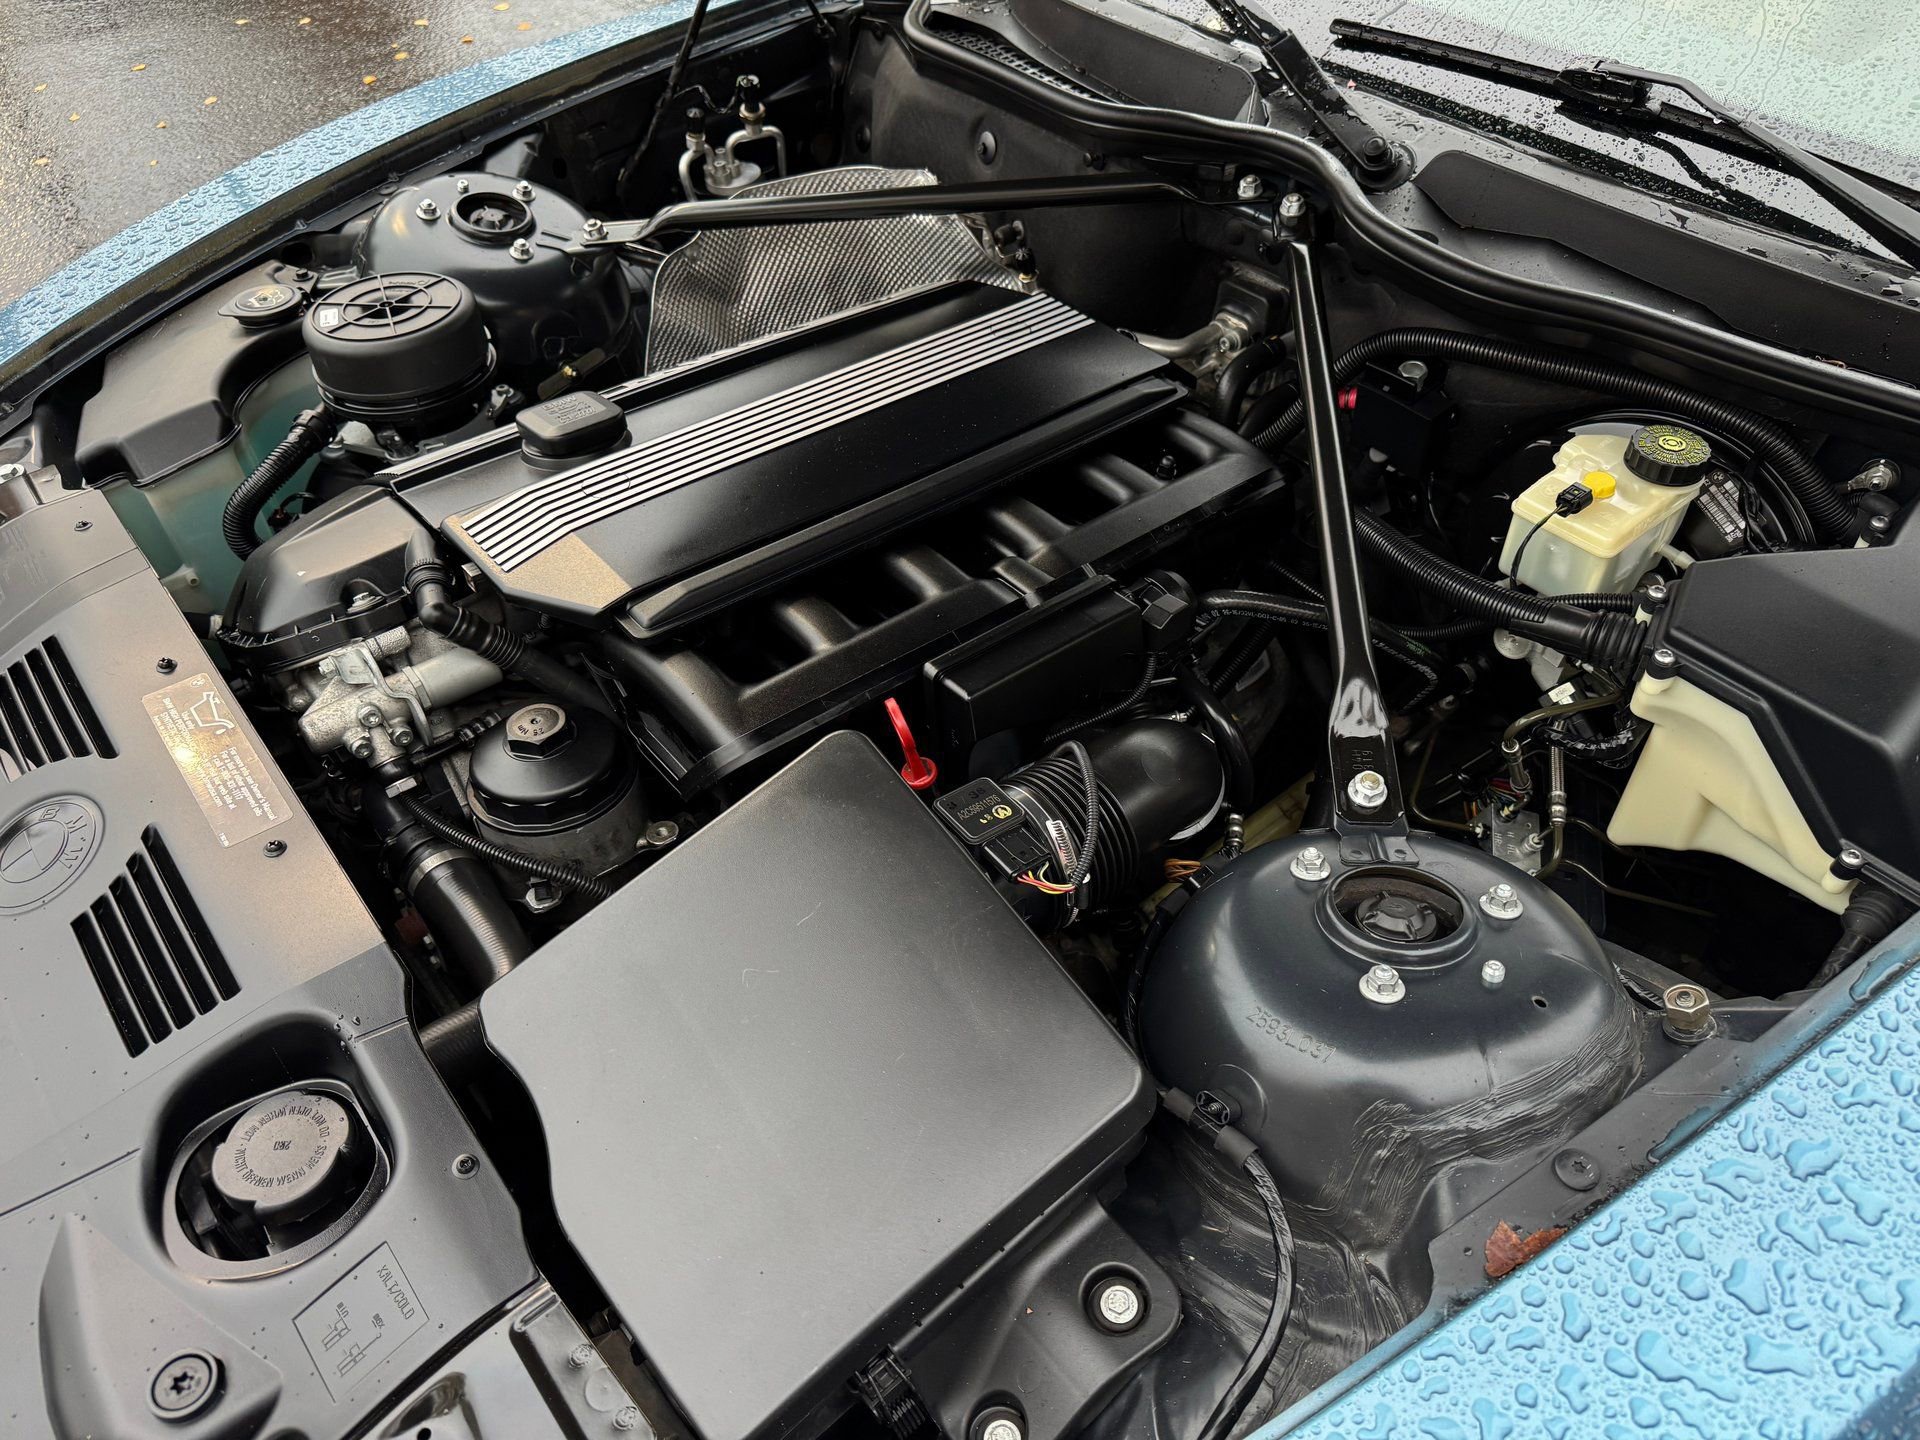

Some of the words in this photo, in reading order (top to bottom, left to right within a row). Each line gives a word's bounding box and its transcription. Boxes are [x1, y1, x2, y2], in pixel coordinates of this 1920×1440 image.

[240, 785, 259, 808] approved
[261, 800, 278, 820] Manual
[39, 807, 87, 869] BMW
[276, 1167, 306, 1188] WENN
[305, 1144, 328, 1170] HEISS
